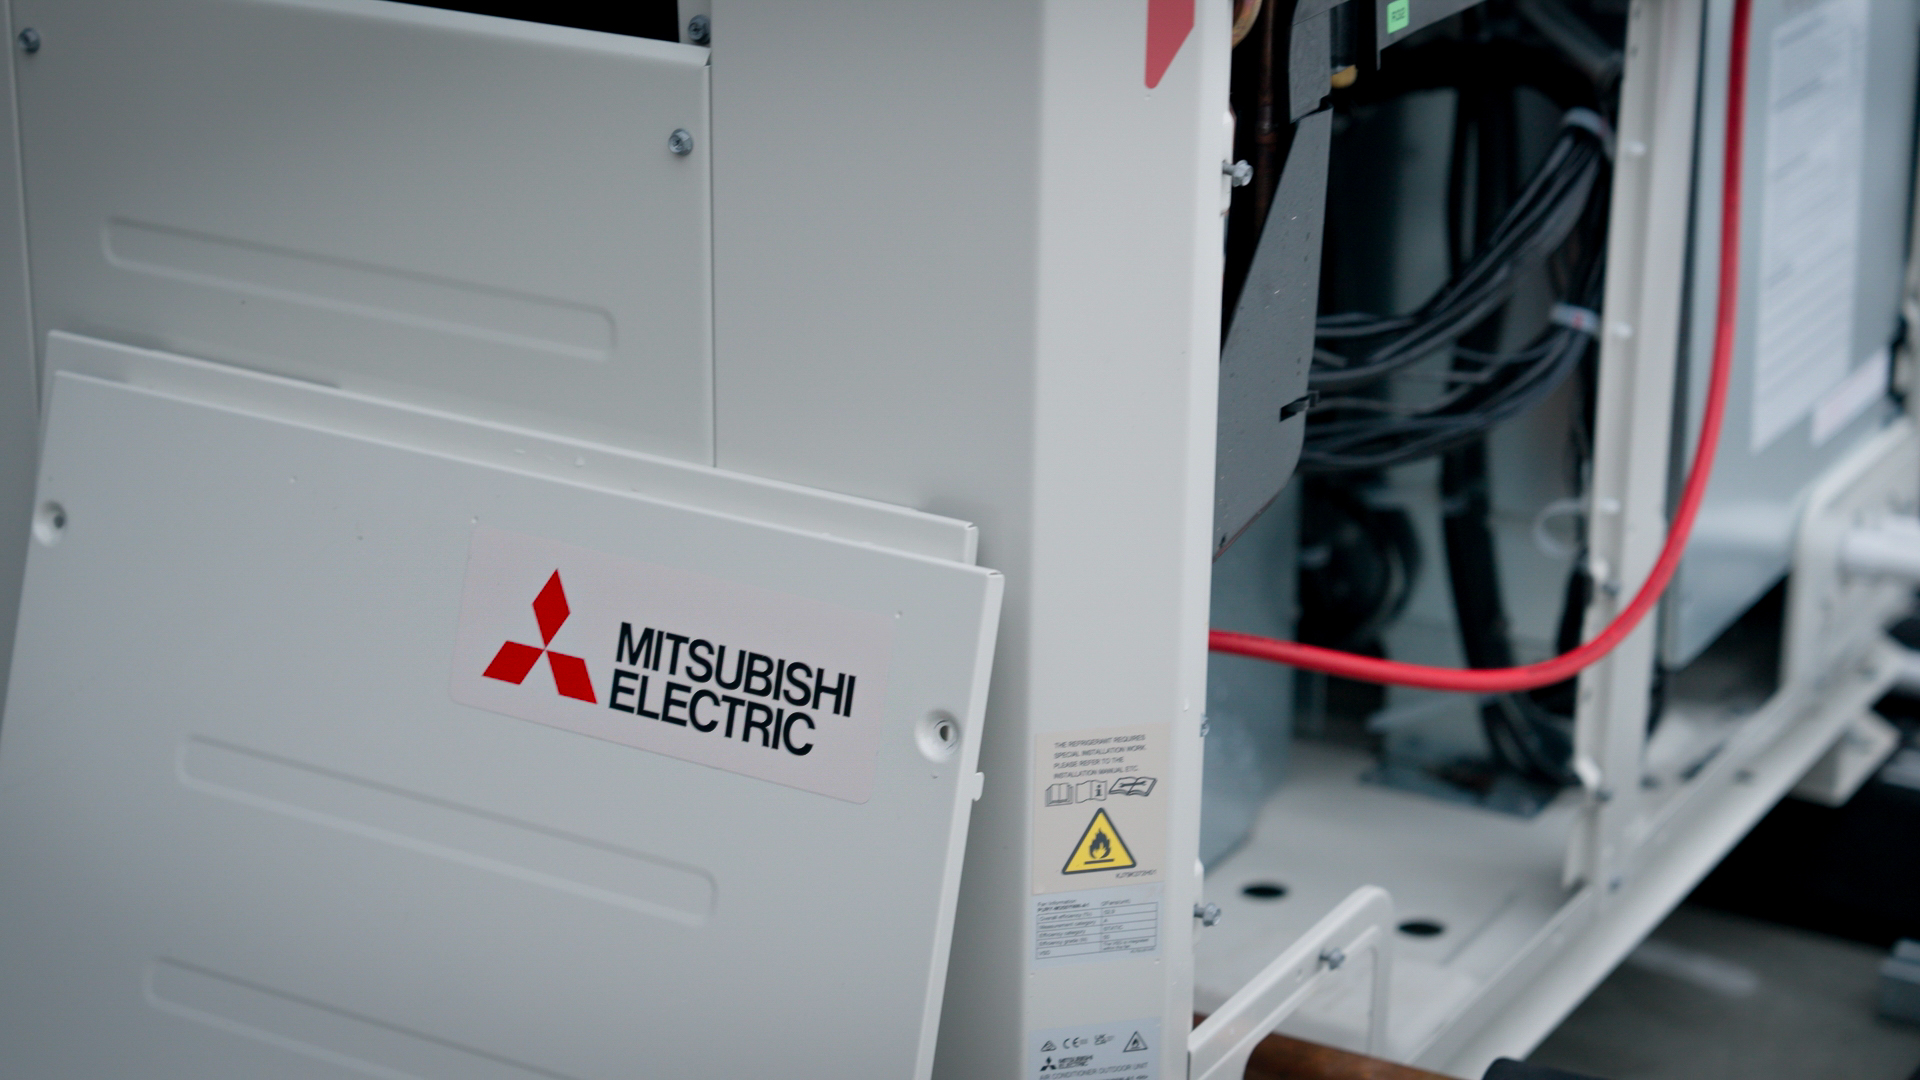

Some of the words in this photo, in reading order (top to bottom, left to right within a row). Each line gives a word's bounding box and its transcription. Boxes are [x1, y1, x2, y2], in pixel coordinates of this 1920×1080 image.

[615, 621, 856, 718] MITSUBISHI
[608, 668, 816, 756] ELECTRIC
[1068, 737, 1112, 748] REFRIGERANT
[1113, 734, 1146, 743] REQUIRES
[1054, 751, 1079, 759] SPECIAL
[1082, 747, 1125, 756] INSTALLATION
[1054, 770, 1097, 779] INSTALLATION
[1098, 766, 1123, 774] MANUAL
[1063, 1036, 1080, 1049] CE
[1052, 1068, 1097, 1080] CONDITIONER
[1099, 1064, 1131, 1074] OUTDOOR
[1133, 1062, 1149, 1070] UNIT
